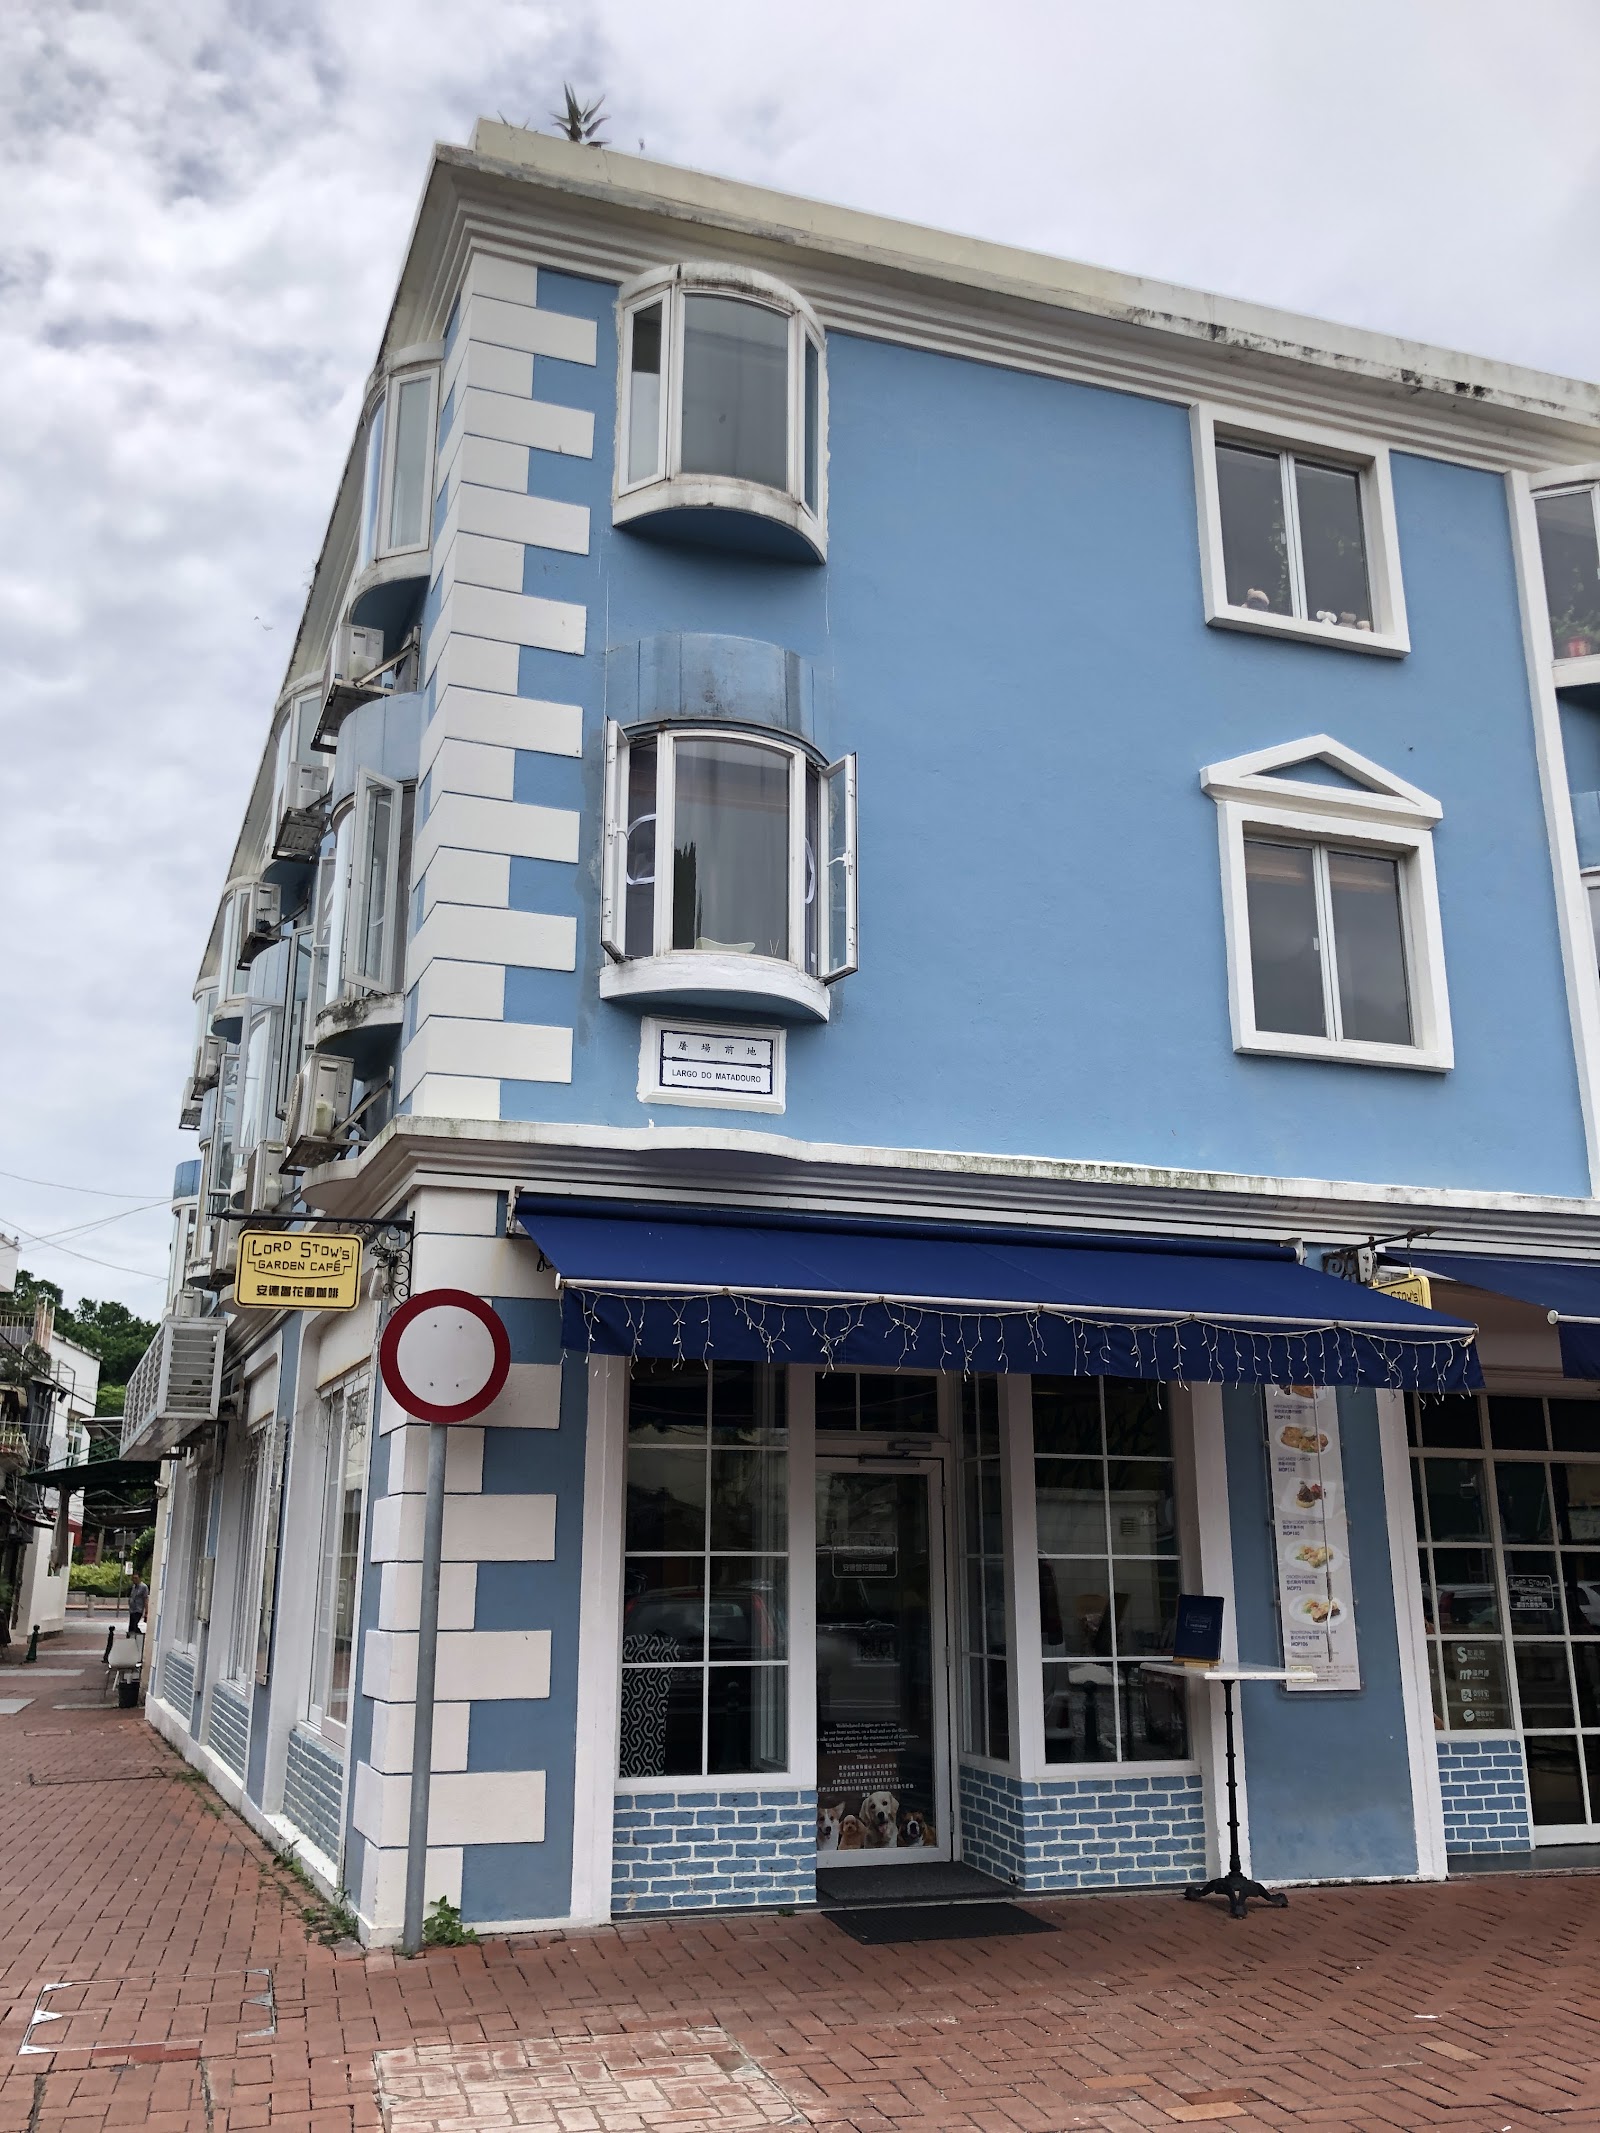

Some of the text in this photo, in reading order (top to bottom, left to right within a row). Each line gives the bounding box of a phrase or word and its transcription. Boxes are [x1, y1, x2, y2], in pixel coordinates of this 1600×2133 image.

[678, 1041, 757, 1056] 屠場前地
[672, 1069, 762, 1083] LARGO DO MATADOURO
[252, 1239, 350, 1260] LORD STOW'S
[258, 1259, 341, 1272] GARDEN CAFÉ
